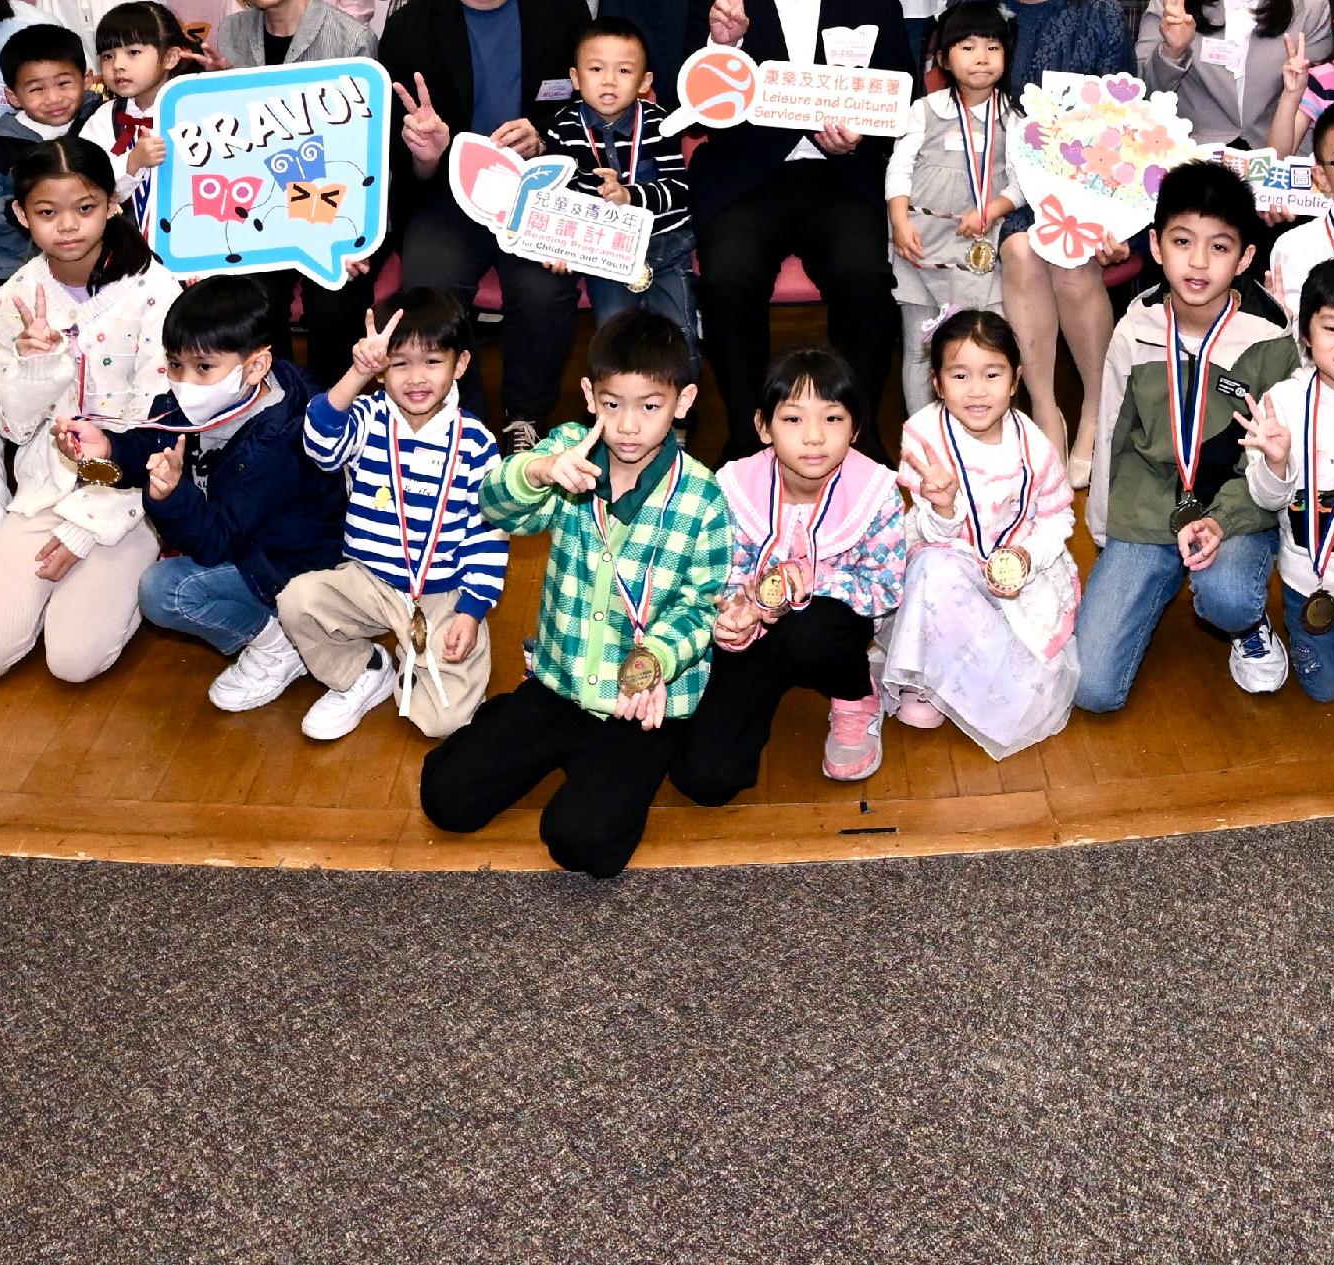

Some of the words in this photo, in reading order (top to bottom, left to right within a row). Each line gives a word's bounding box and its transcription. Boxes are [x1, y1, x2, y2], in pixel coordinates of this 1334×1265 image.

[763, 69, 900, 96] 康樂及文化事務署
[762, 90, 811, 105] Leisure
[814, 95, 840, 109] and
[844, 98, 898, 113] Cultural
[168, 75, 373, 167] BRAVO!
[754, 106, 811, 122] Services
[815, 111, 896, 130] Department
[533, 191, 639, 230] 兒童及青少年
[1287, 194, 1328, 209] Public
[523, 229, 567, 247] Reading
[570, 240, 632, 262] Programme
[526, 211, 635, 253] 閱讀計劃
[522, 240, 533, 248] for
[536, 242, 576, 258] Children
[579, 253, 598, 263] and
[601, 257, 629, 271] Youth
